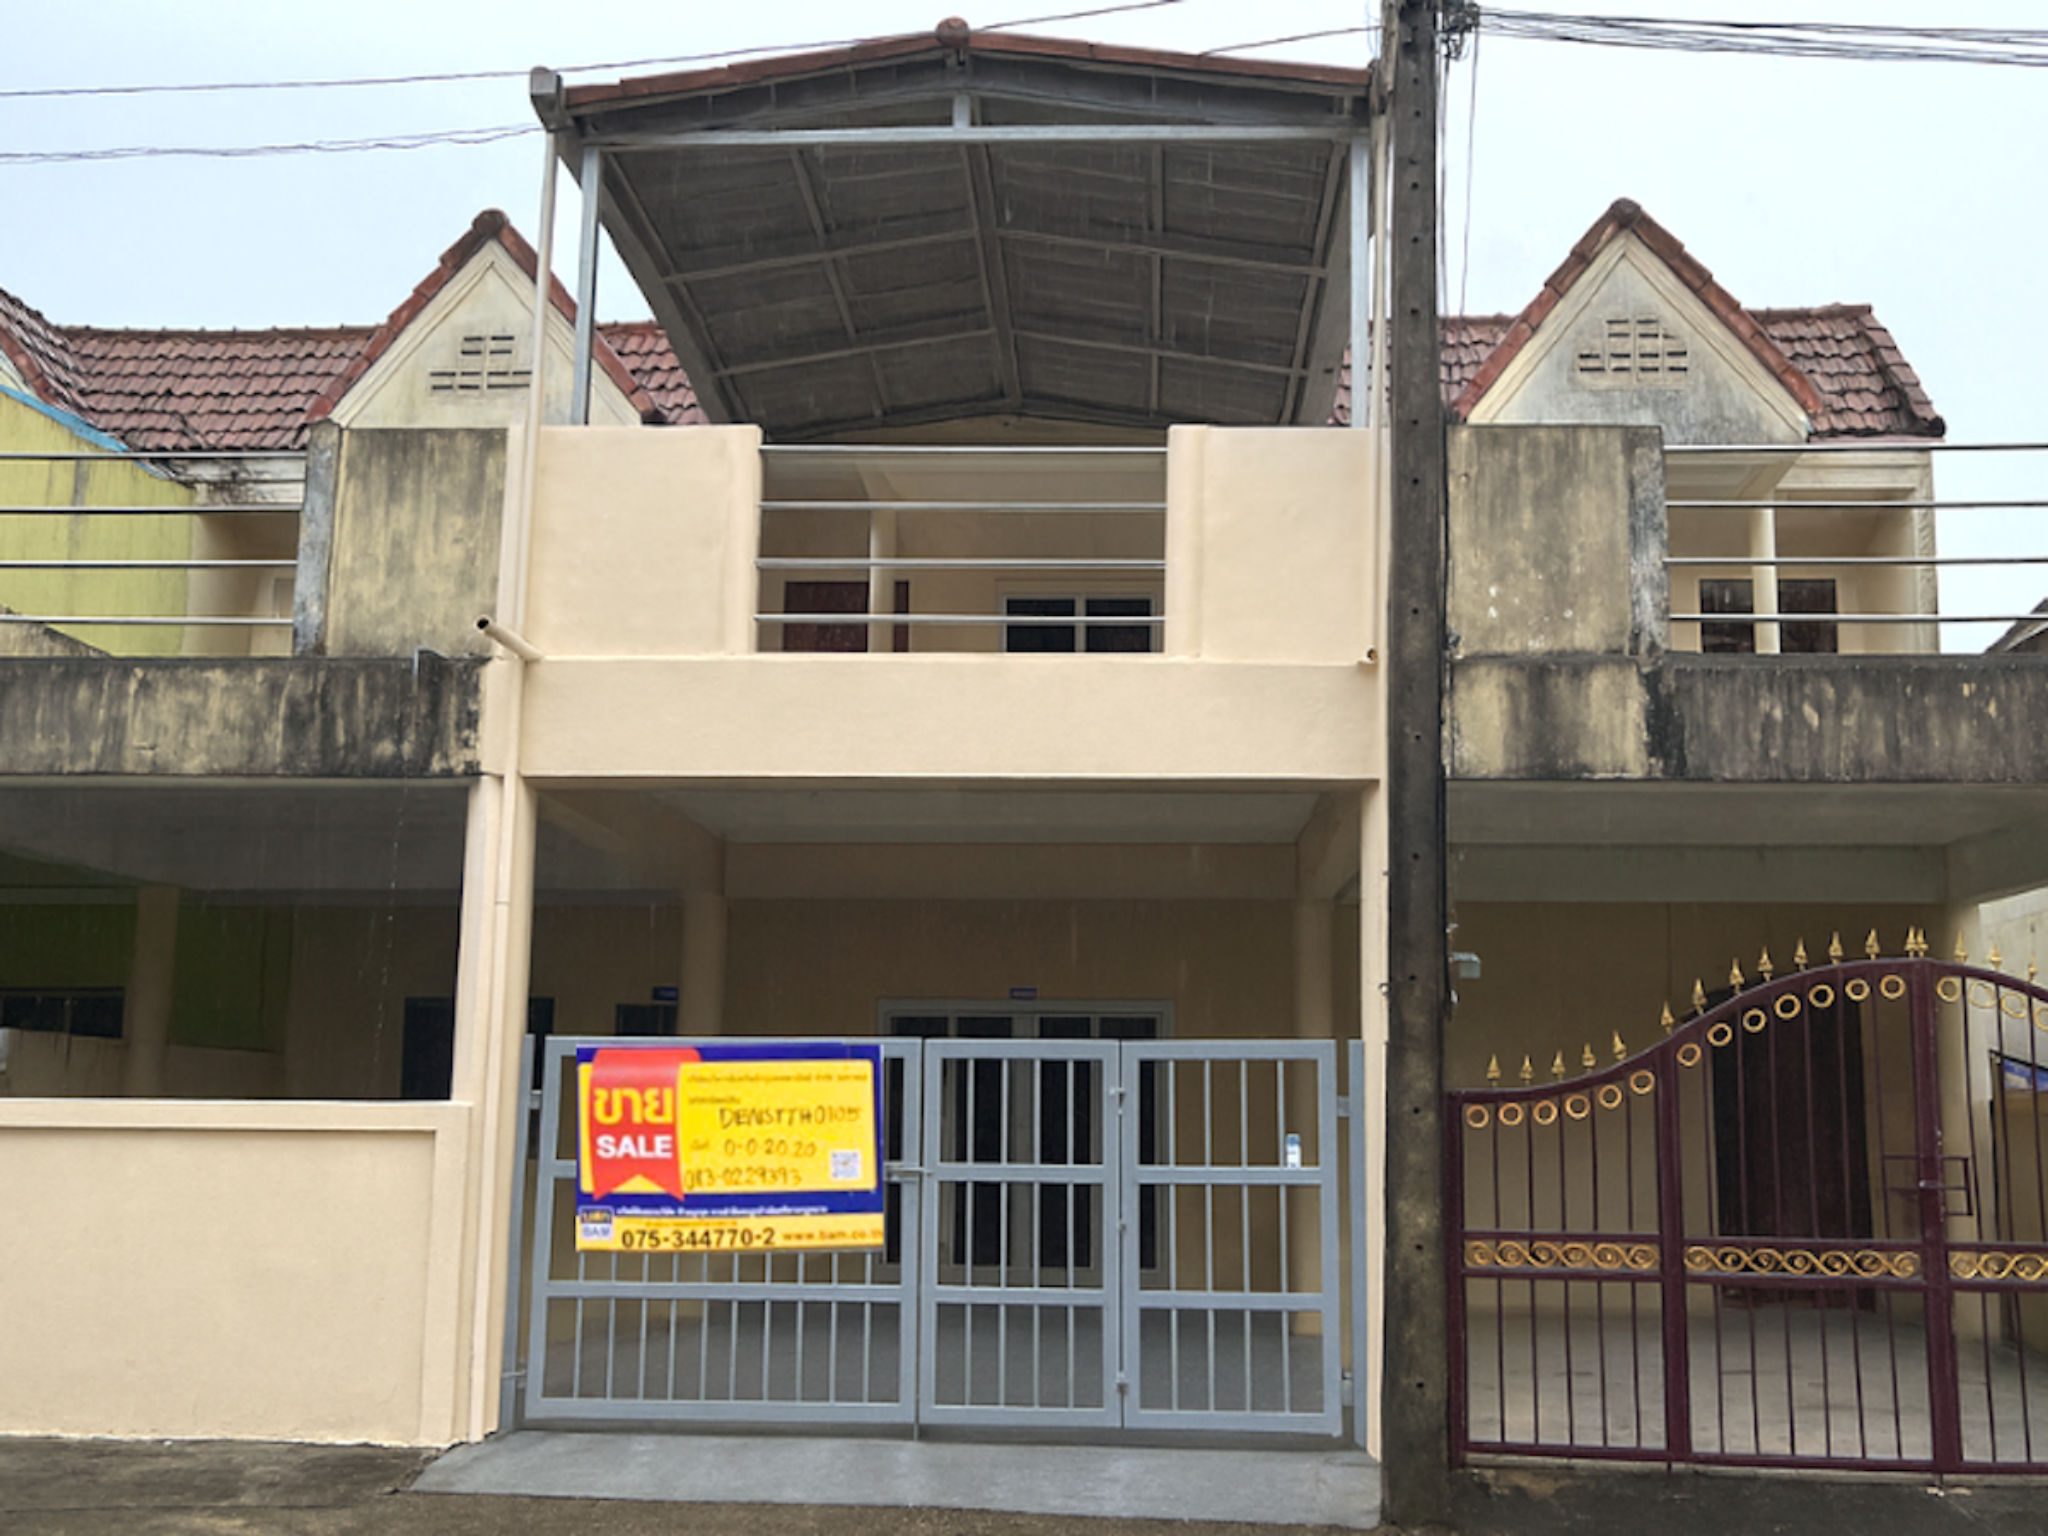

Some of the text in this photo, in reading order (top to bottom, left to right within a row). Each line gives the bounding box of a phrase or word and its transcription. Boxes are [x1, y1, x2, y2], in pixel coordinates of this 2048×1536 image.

[594, 1087, 673, 1125] ขาย
[596, 1135, 672, 1159] SALE
[622, 1227, 775, 1248] 075-344770-2
